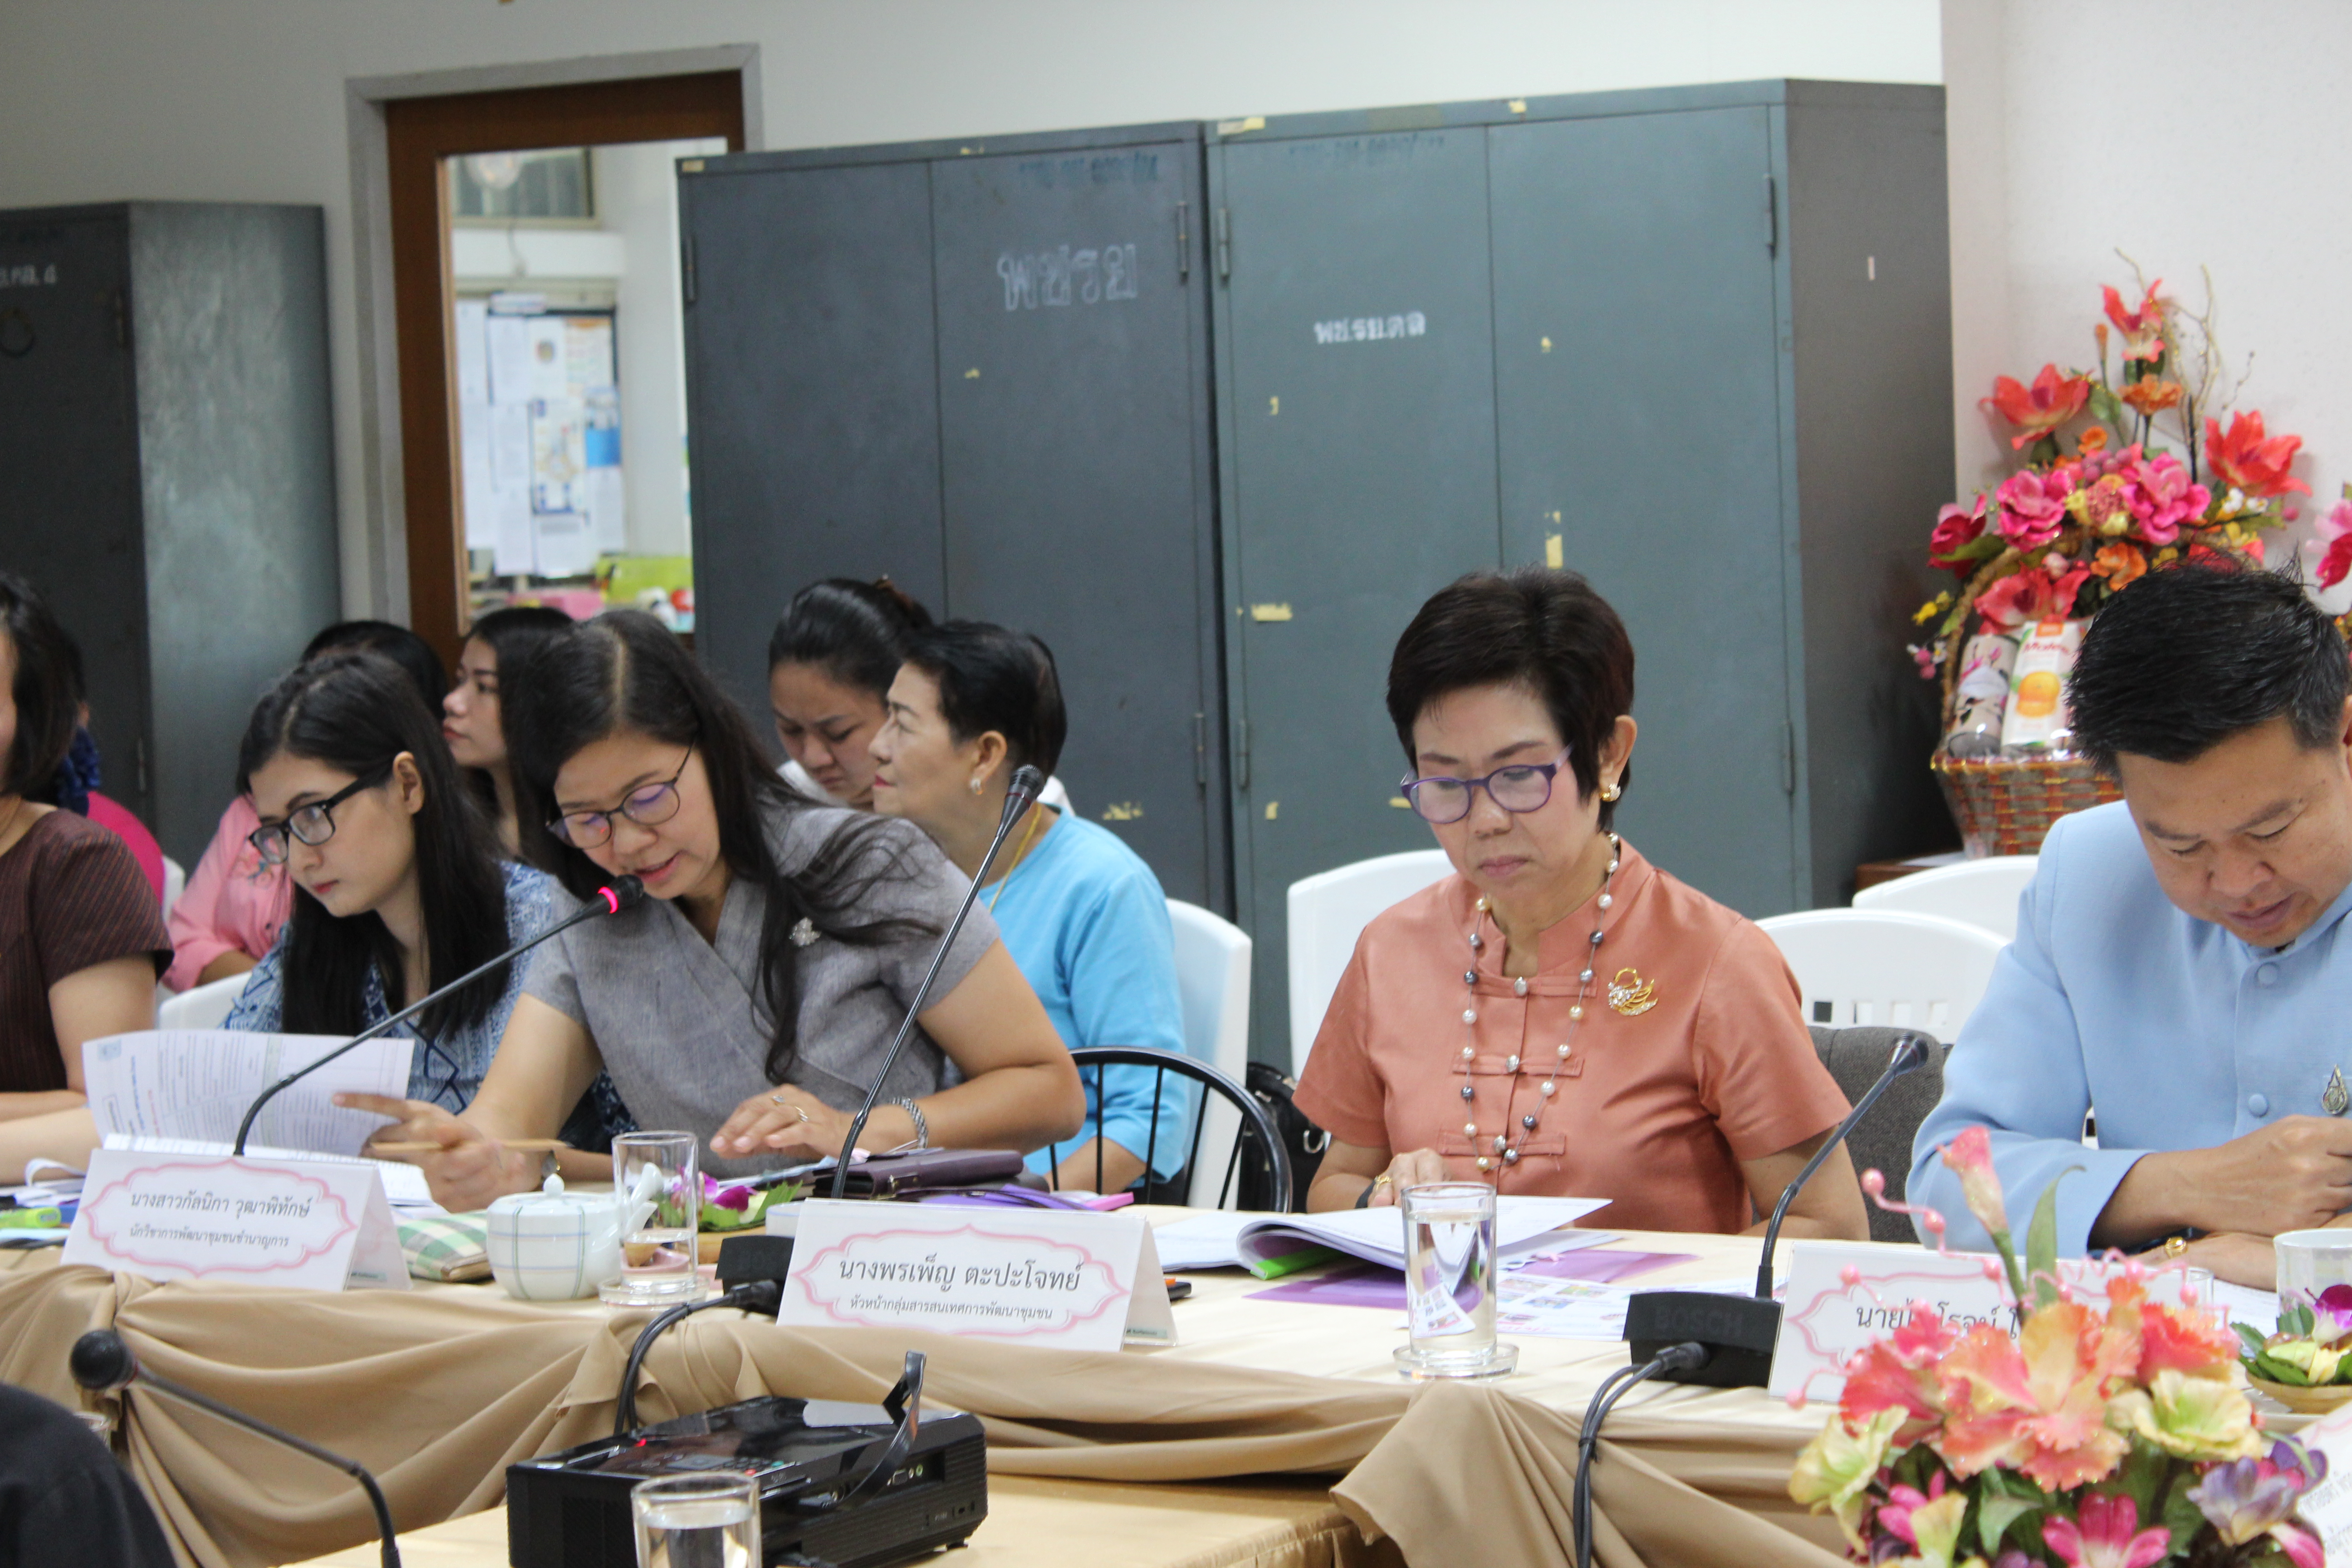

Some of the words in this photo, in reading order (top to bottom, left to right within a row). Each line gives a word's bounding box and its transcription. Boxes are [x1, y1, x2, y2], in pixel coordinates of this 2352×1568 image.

[840, 1252, 956, 1292] นางพรเพ็ญ
[965, 1258, 1084, 1291] ตะปะโจทย์
[850, 1294, 1053, 1323] หัวหน้ากลุ่มสารสนเทศการพัฒนาชุมชน
